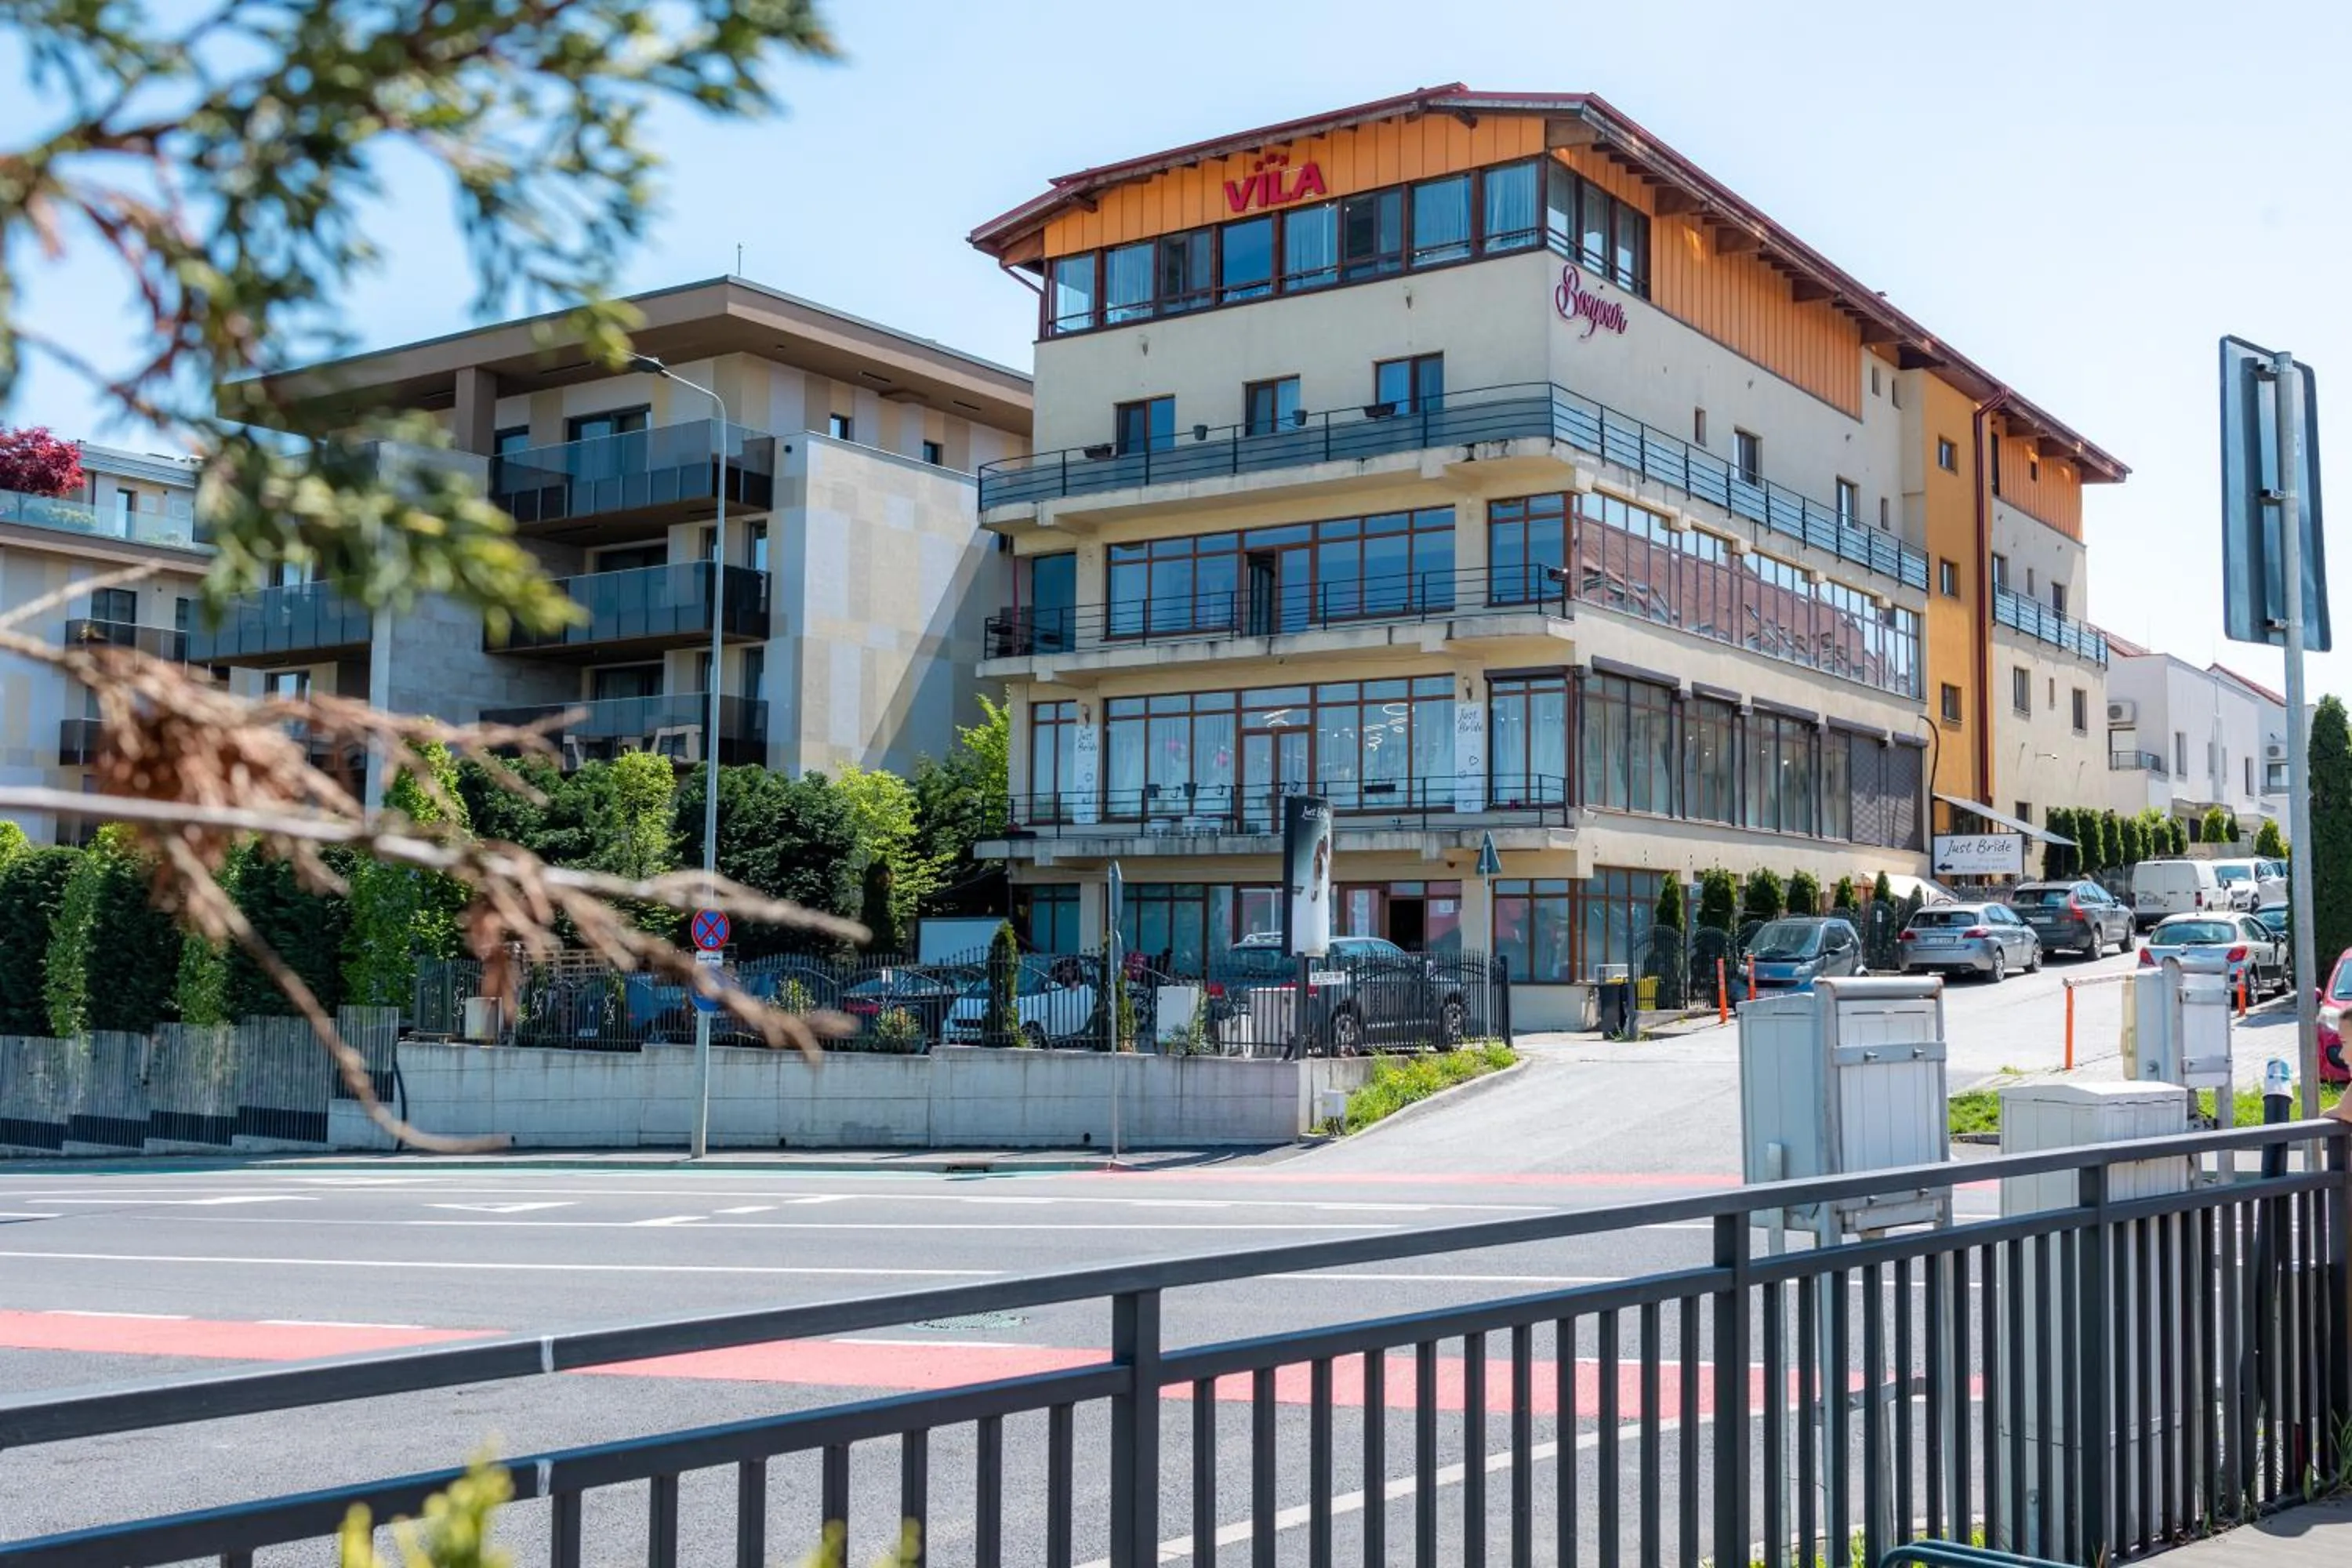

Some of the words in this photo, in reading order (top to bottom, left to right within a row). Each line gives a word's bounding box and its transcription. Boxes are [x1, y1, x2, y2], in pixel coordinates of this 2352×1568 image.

[1224, 162, 1327, 213] VILA
[1944, 839, 1972, 857] Just
[1976, 837, 2013, 855] Bride
